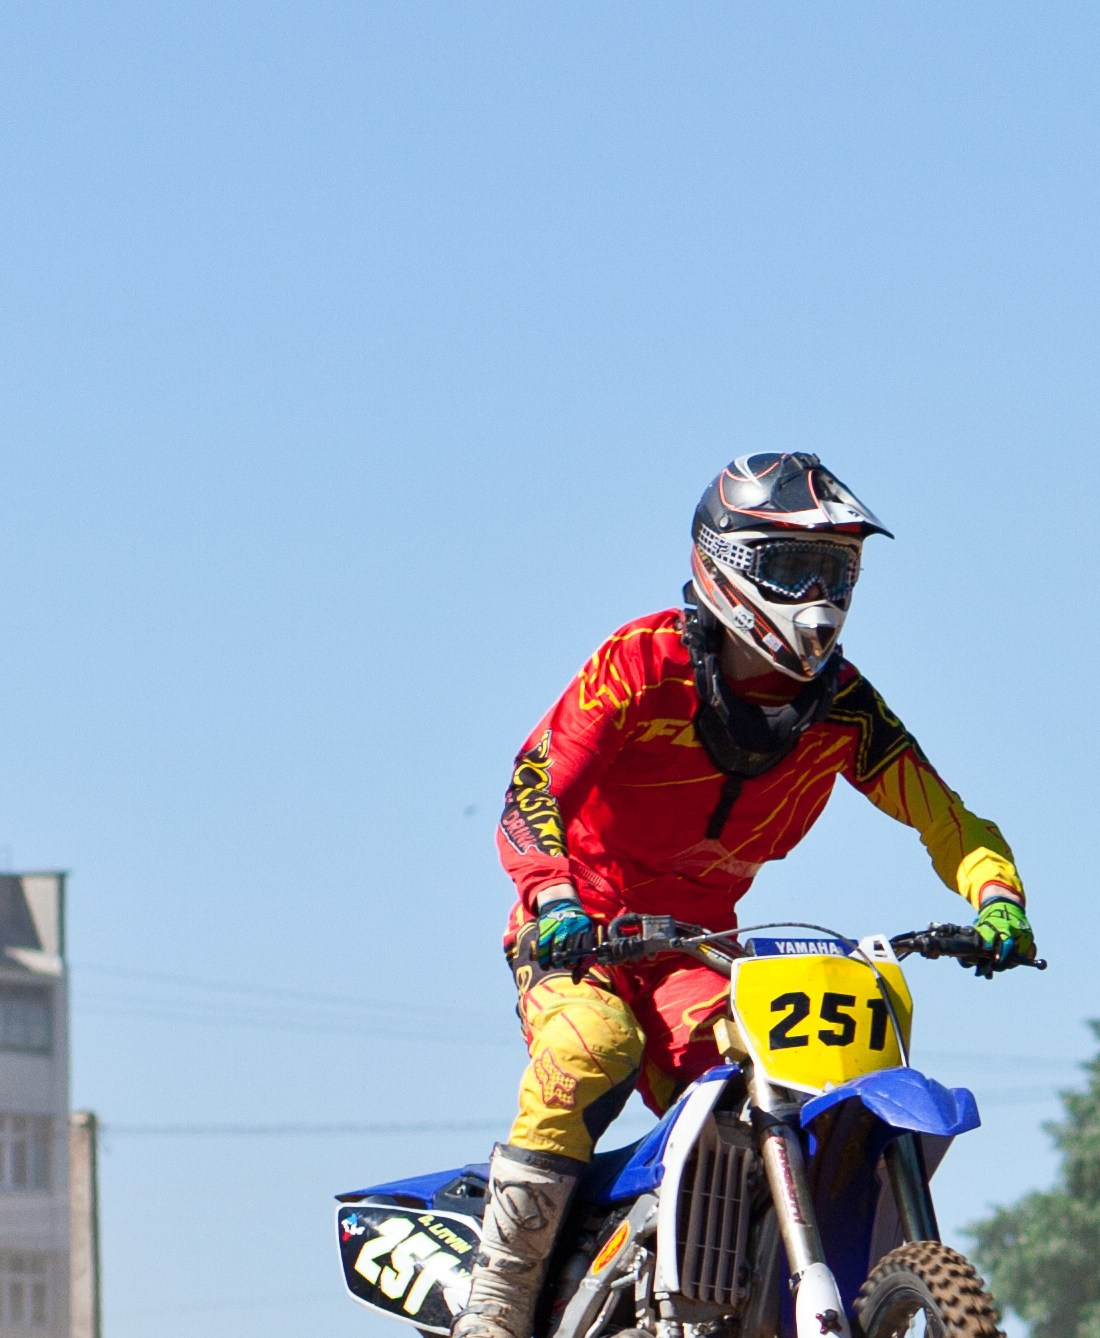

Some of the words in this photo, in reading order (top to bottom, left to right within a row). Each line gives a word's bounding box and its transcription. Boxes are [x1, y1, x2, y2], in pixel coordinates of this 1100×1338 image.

[775, 941, 840, 955] YAMAHA
[769, 991, 890, 1051] 251
[428, 1222, 473, 1254] LITVIN
[354, 1217, 462, 1316] 251
